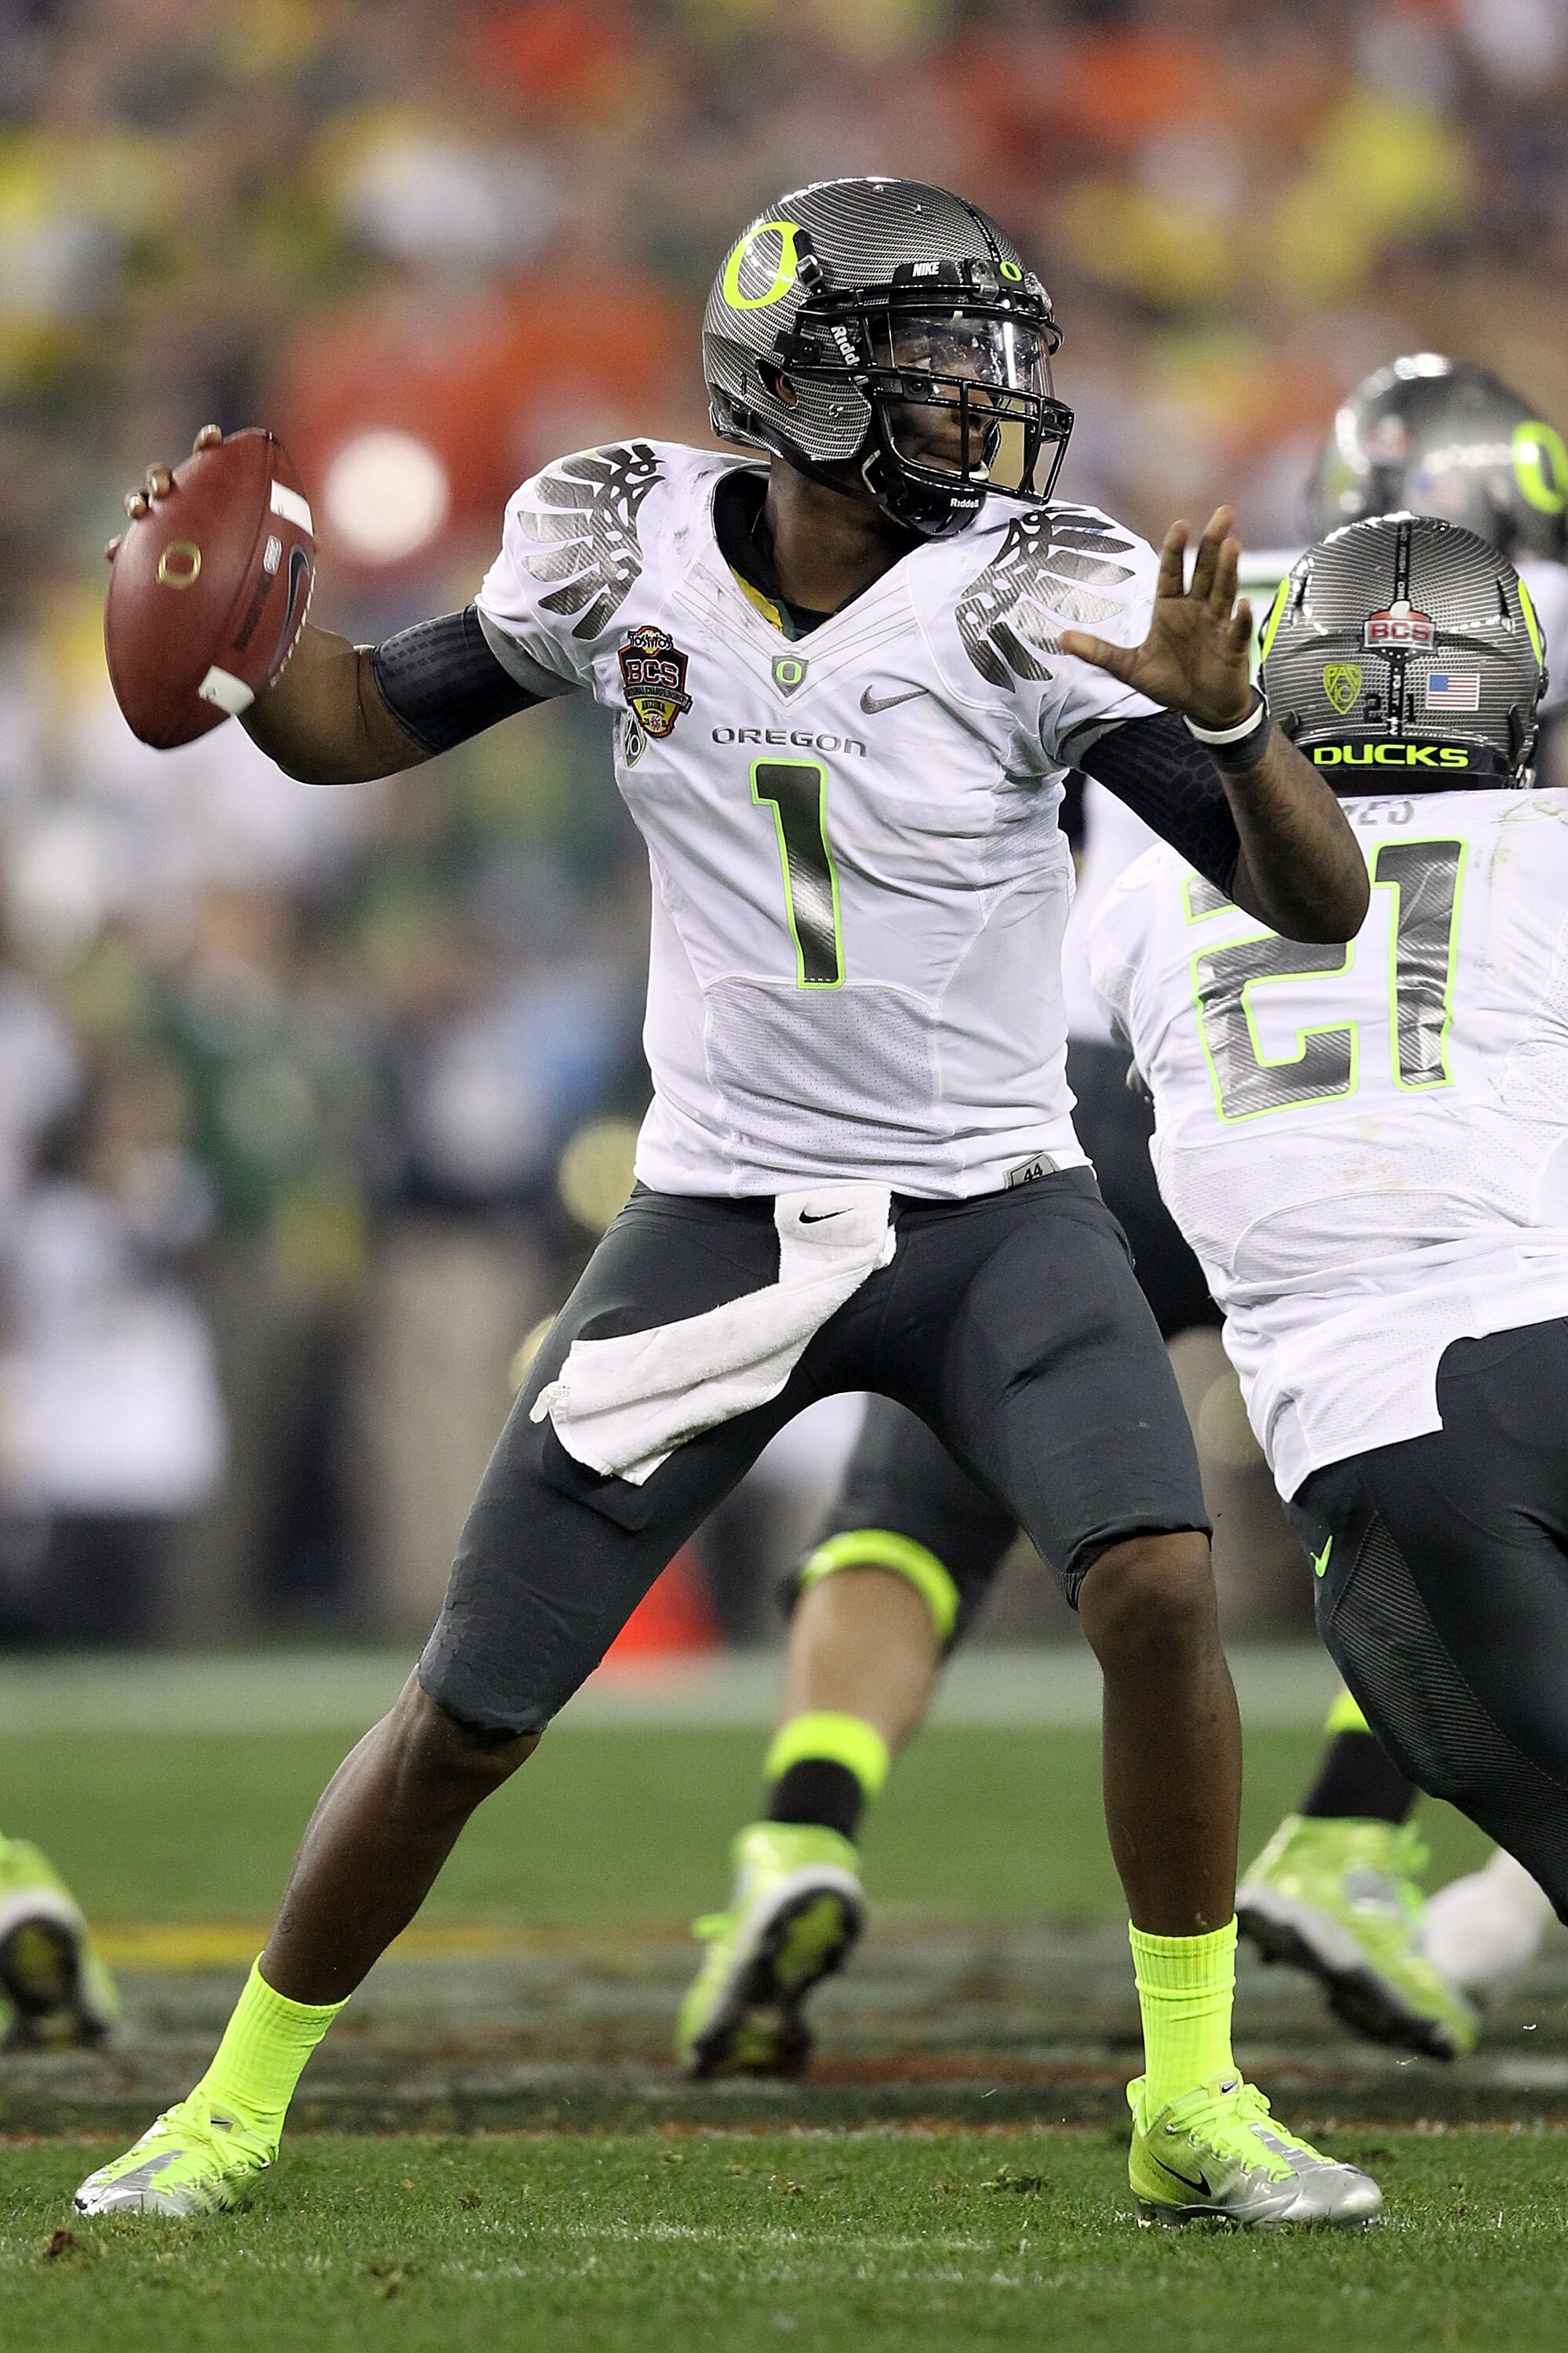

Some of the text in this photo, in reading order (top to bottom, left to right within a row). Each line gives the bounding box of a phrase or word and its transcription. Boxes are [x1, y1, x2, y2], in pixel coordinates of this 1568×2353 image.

[722, 222, 799, 309] O
[912, 261, 940, 277] NIKE
[831, 325, 870, 386] Riddll
[950, 498, 980, 508] Riddell
[1370, 622, 1430, 641] BCS
[626, 659, 679, 689] BCS
[712, 727, 868, 758] OREGON
[1314, 744, 1469, 768] DUCKS
[749, 757, 846, 990] 1
[1181, 836, 1469, 1124] 21
[1024, 1162, 1043, 1182] 44
